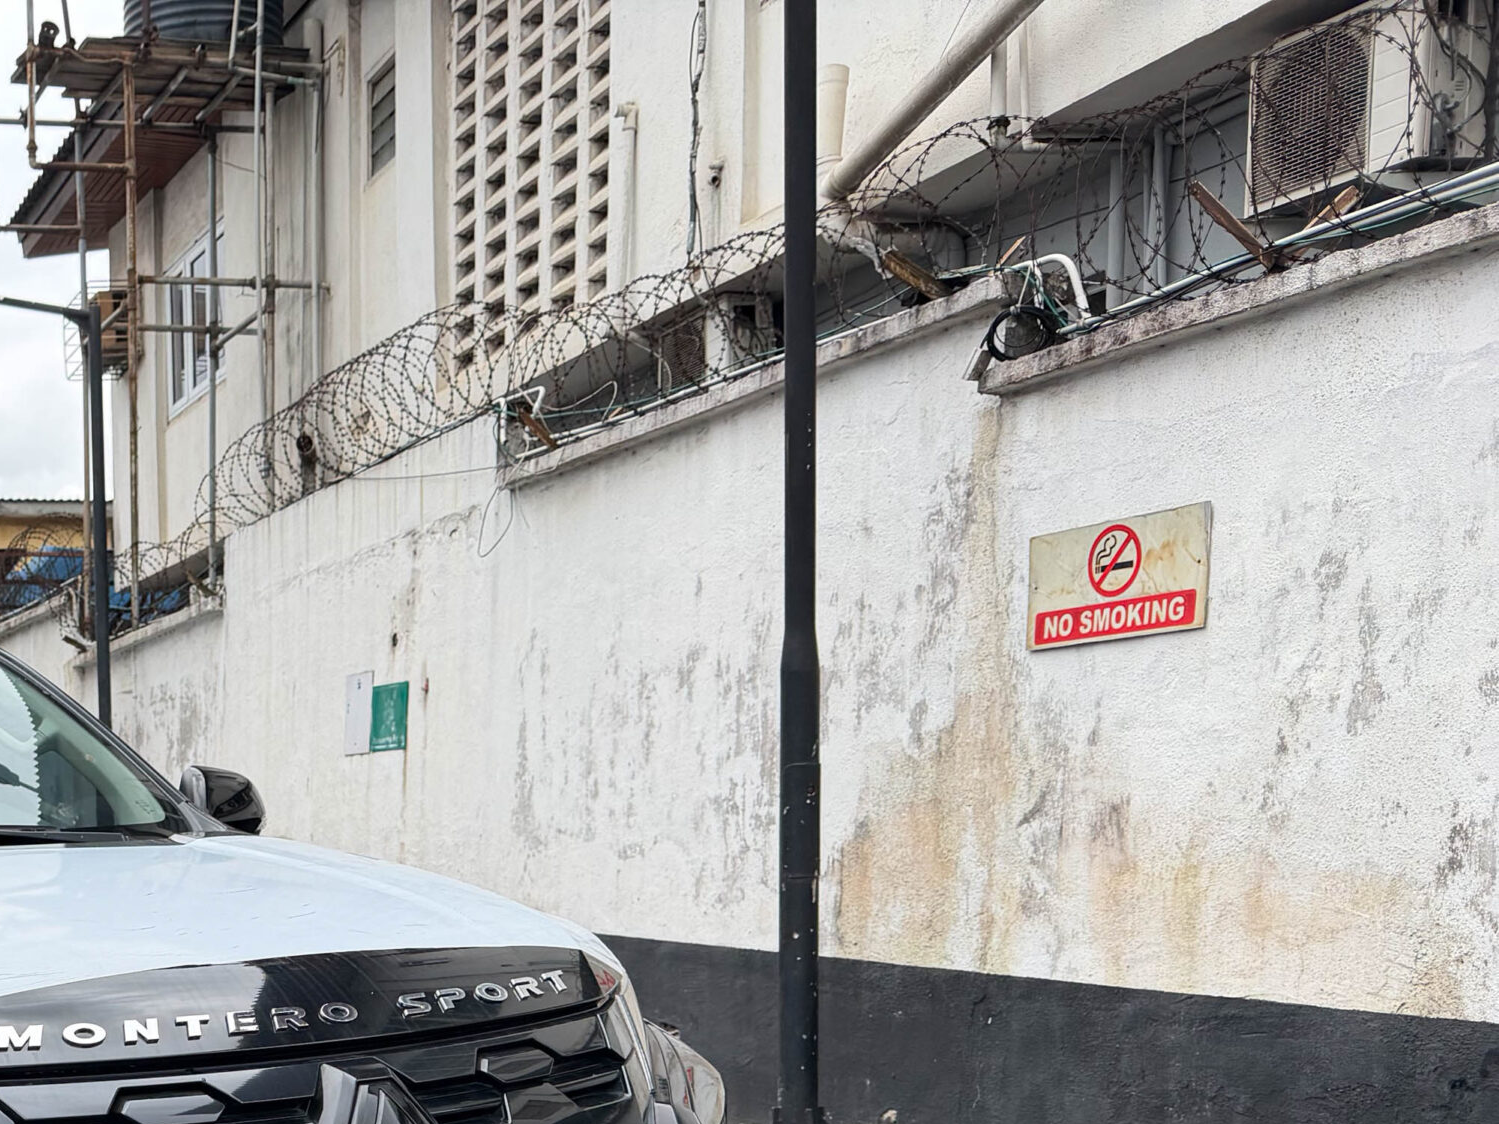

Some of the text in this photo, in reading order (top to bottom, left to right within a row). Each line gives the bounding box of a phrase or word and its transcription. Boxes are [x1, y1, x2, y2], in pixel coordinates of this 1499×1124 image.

[1043, 595, 1185, 640] NO SMOKING
[396, 969, 567, 1018] SPORT
